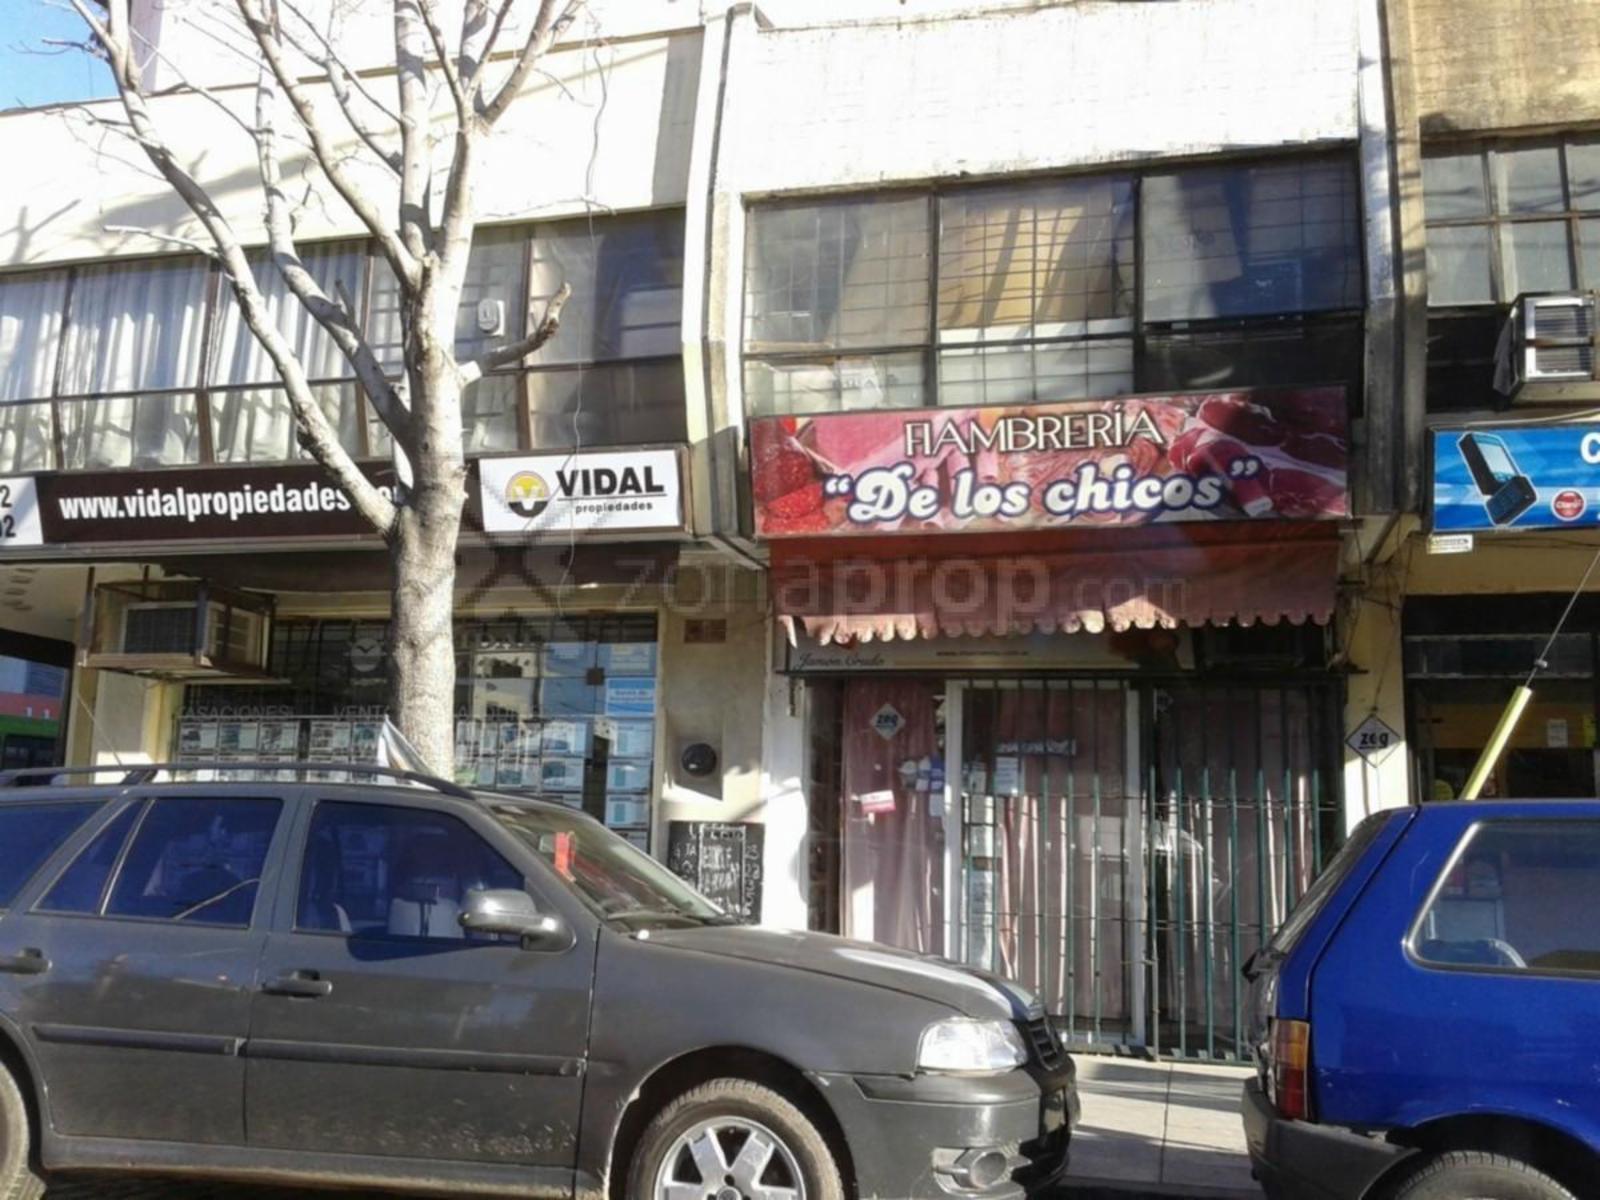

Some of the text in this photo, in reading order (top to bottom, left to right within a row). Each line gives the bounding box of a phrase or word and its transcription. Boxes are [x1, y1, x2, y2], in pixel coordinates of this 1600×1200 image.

[904, 403, 1165, 457] FIAMBRERÍA
[555, 465, 665, 497] VIDAL
[952, 469, 1040, 518] los
[575, 501, 654, 515] propiedades
